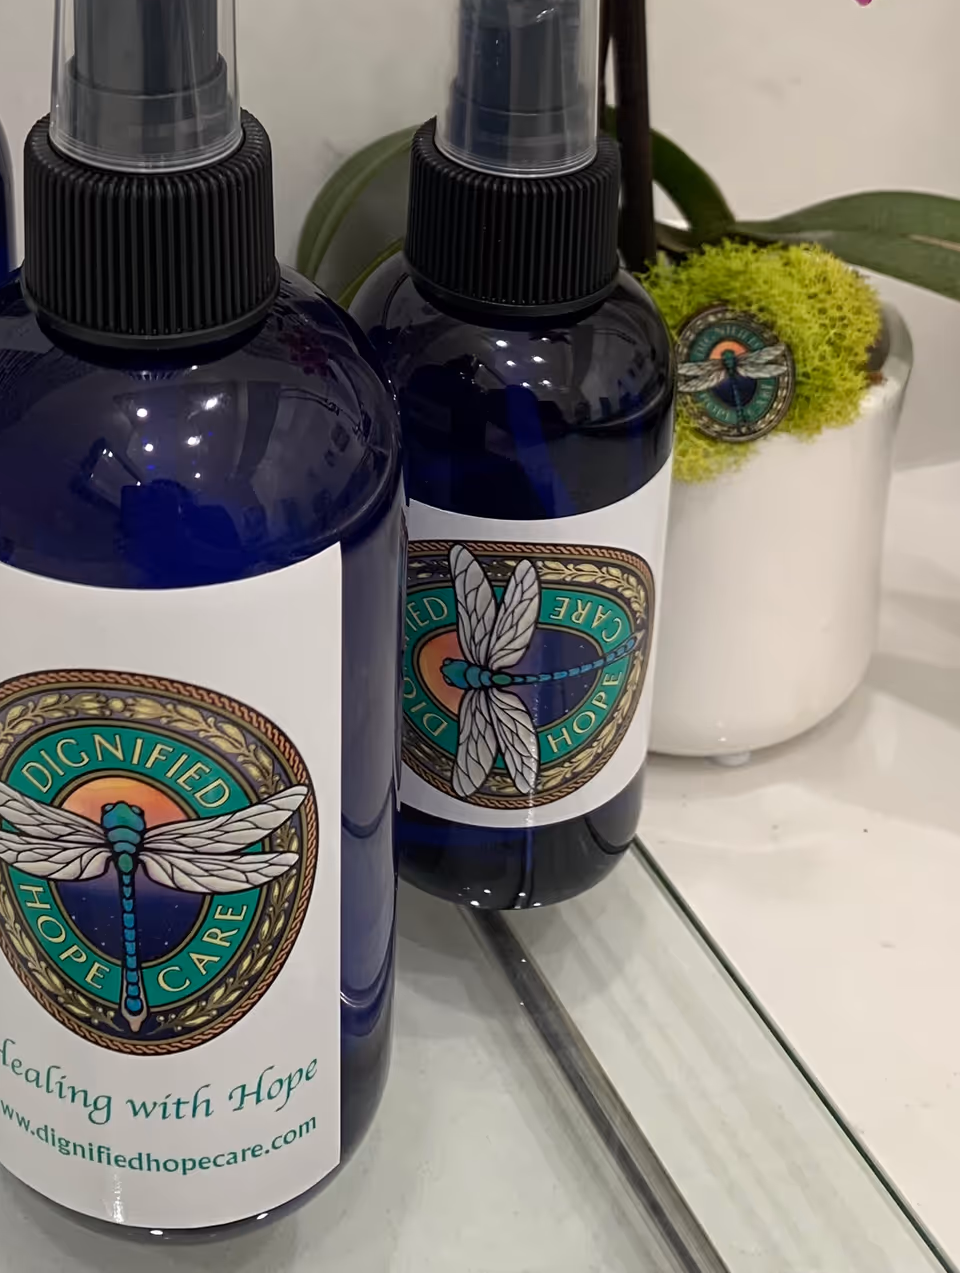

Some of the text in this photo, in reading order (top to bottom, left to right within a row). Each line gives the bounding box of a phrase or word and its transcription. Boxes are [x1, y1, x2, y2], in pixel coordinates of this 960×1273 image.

[547, 597, 622, 753] HOPE CARE
[21, 734, 232, 809] DIGNIFIED
[19, 883, 249, 993] HOPE CARE
[125, 1084, 214, 1120] with
[229, 1058, 318, 1112] Hope
